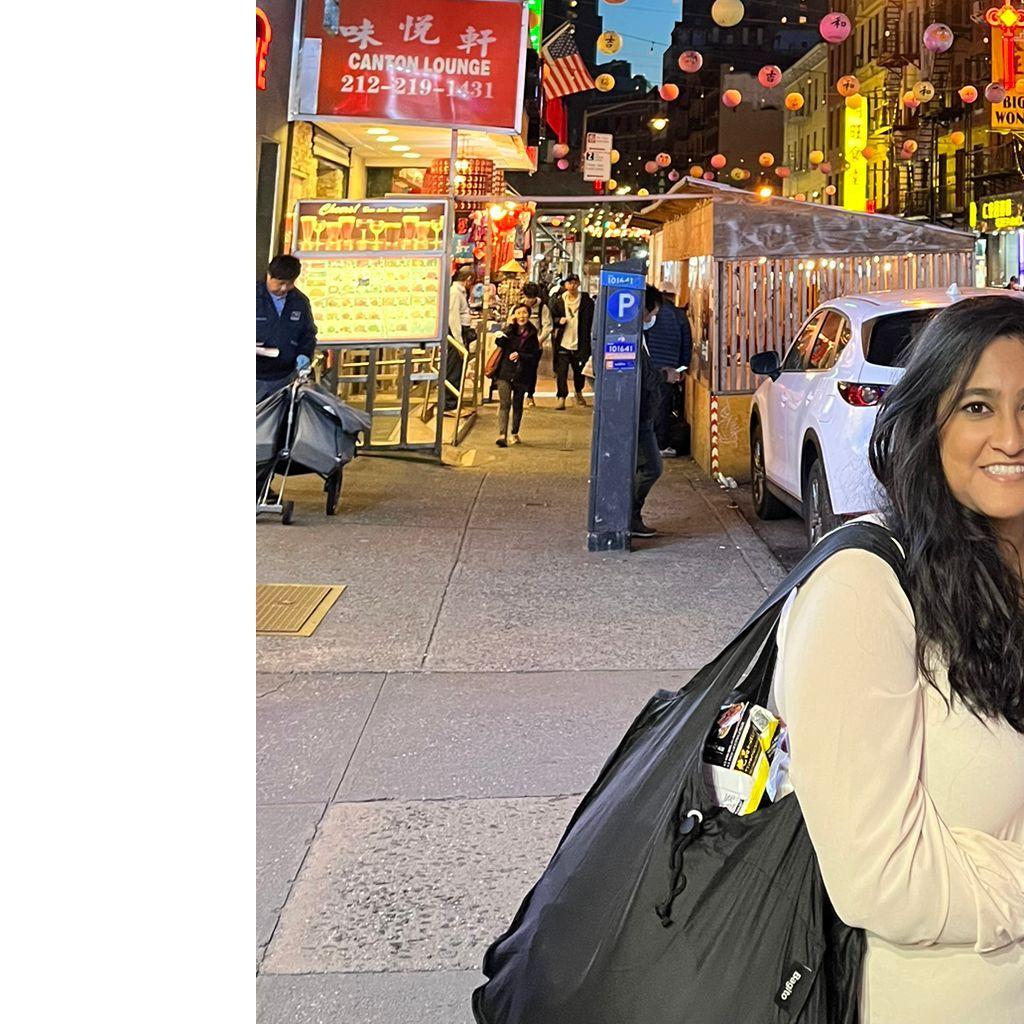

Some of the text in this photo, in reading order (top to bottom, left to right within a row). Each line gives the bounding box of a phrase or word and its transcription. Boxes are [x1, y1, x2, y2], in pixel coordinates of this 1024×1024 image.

[348, 52, 491, 76] CANTON LOUNGE
[340, 75, 494, 99] 212-219-1431
[618, 293, 635, 318] P
[608, 345, 633, 353] 101641
